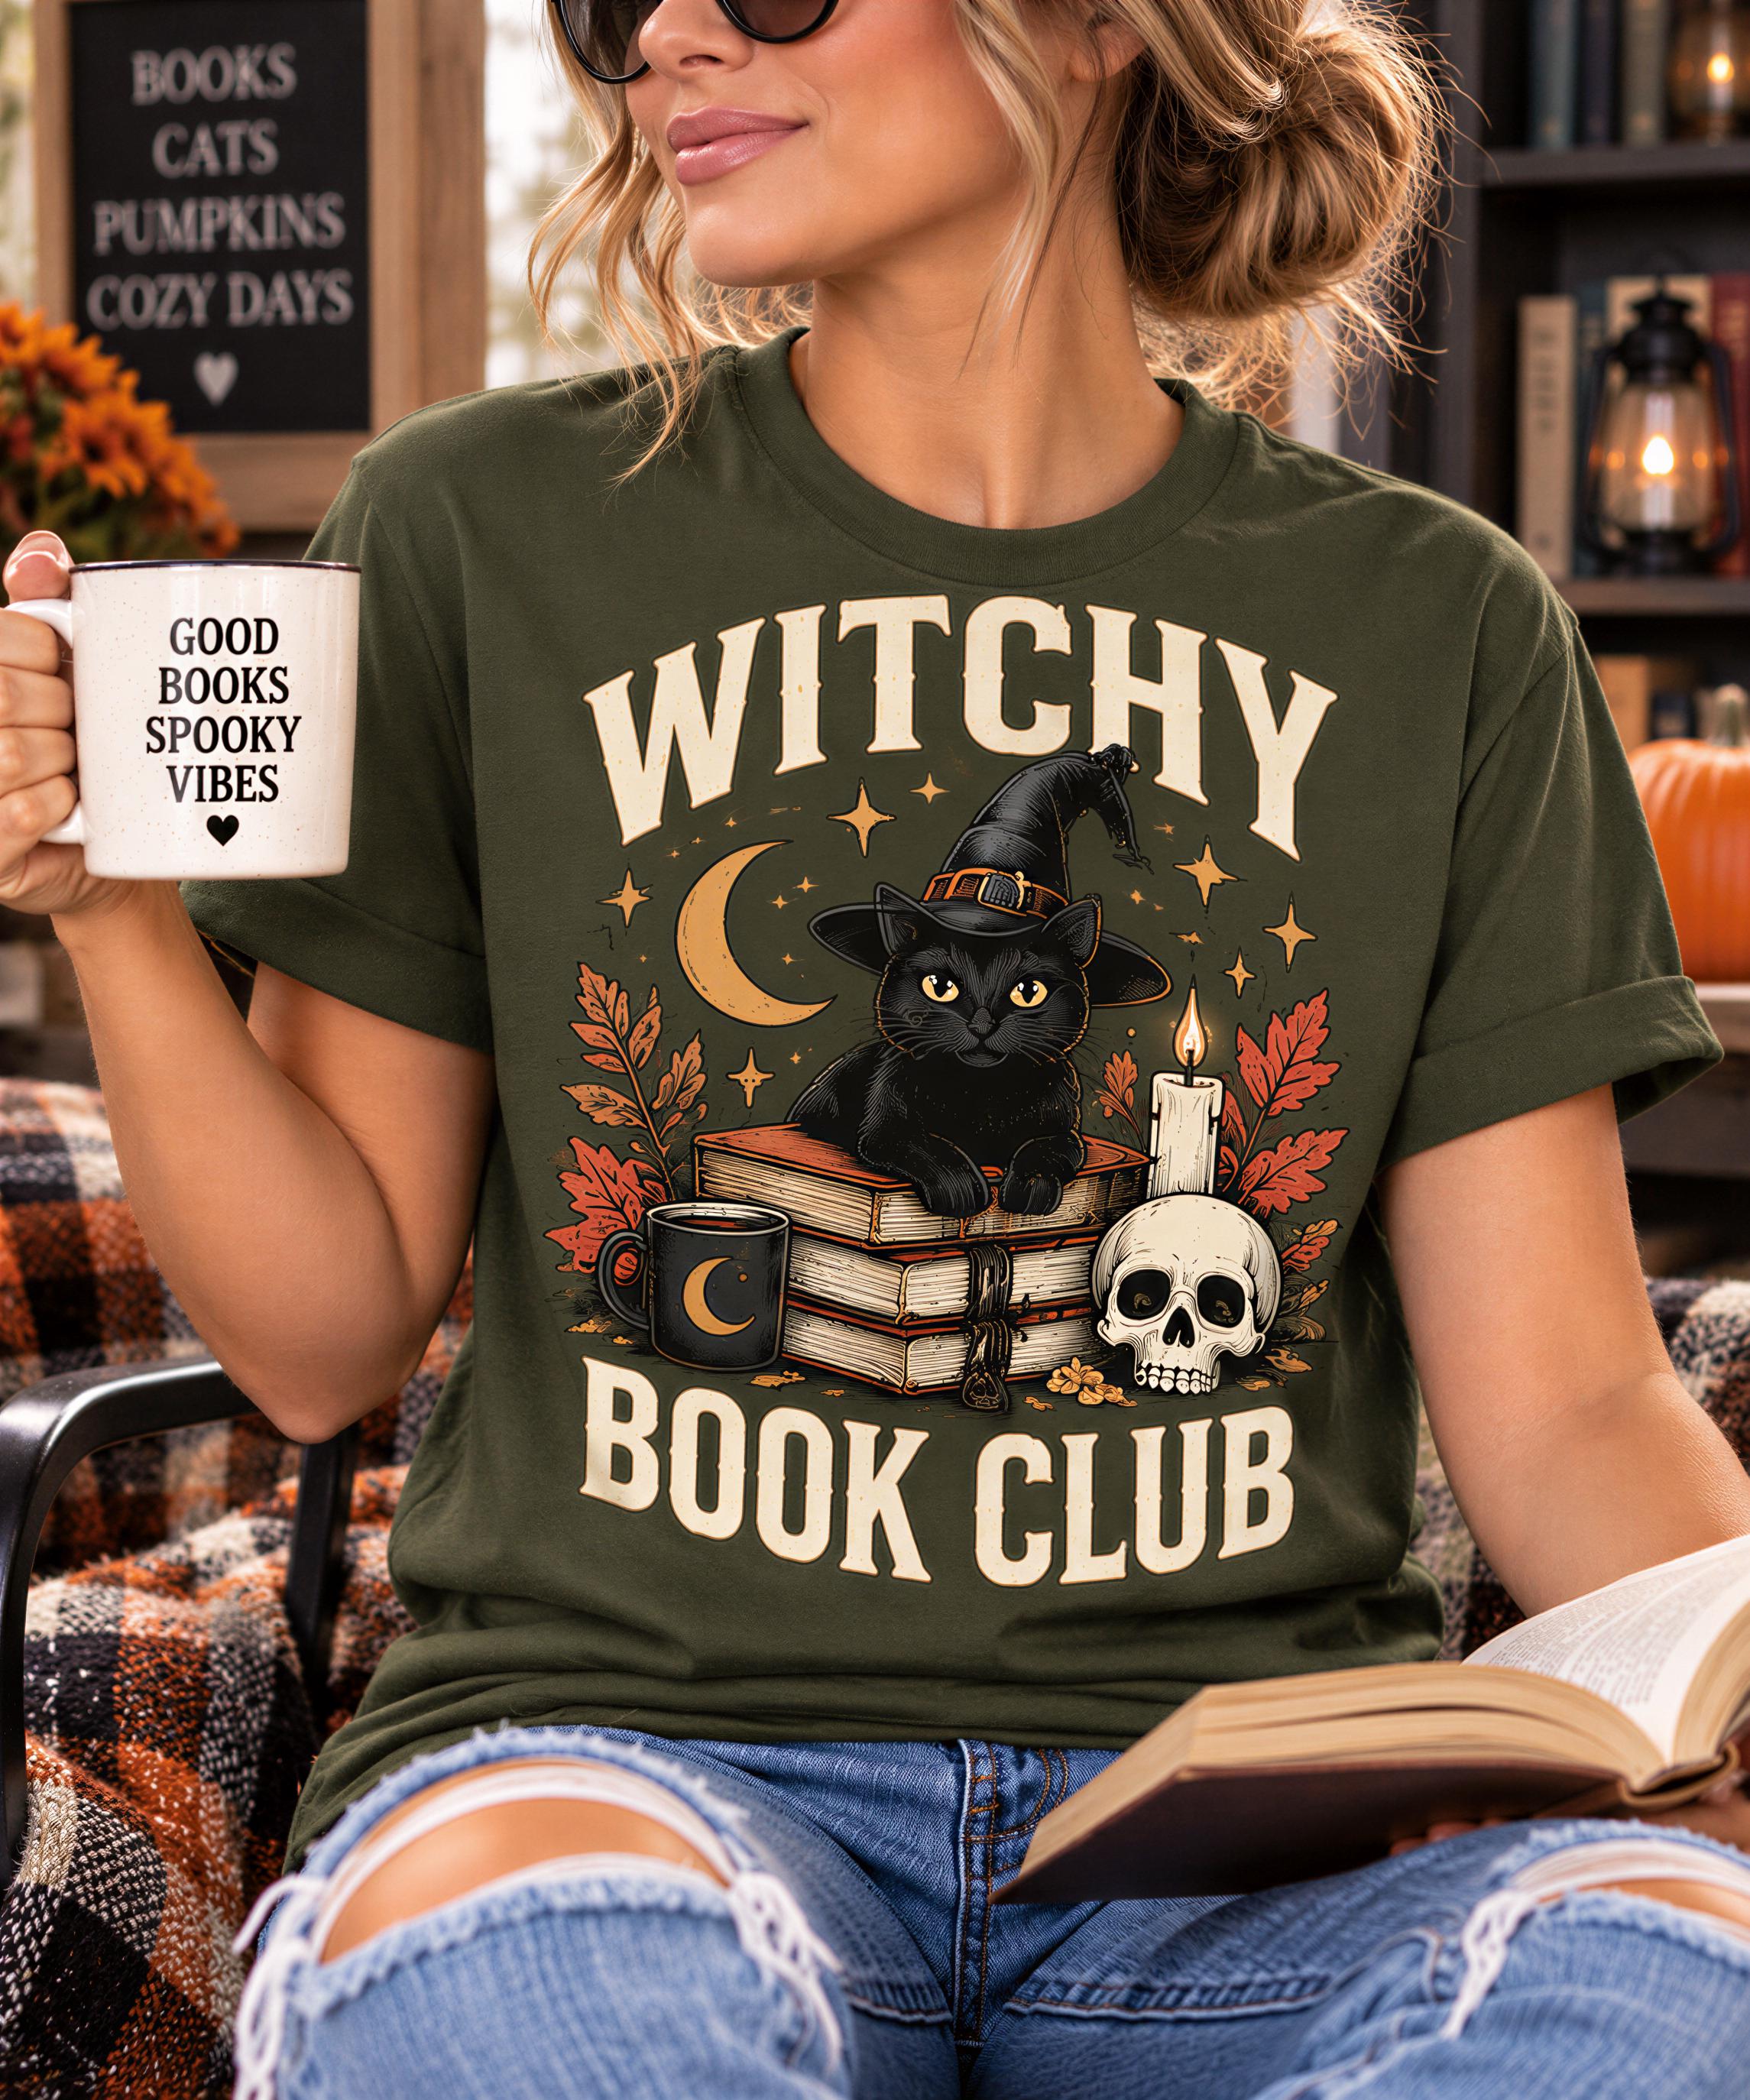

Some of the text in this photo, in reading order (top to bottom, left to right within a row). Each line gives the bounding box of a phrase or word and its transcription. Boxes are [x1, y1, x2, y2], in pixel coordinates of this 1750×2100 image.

[131, 42, 297, 105] BOOKS
[152, 118, 279, 178] CATS
[93, 193, 345, 255] PUMPKINS
[86, 269, 353, 330] COZY DAYS
[169, 617, 279, 656] GOOD
[158, 666, 290, 705] BOOKS
[145, 715, 302, 753] SPOOKY
[583, 595, 1338, 860] WITCHY
[166, 764, 279, 802] VIBES
[579, 1356, 1295, 1586] BOOK CLUB
